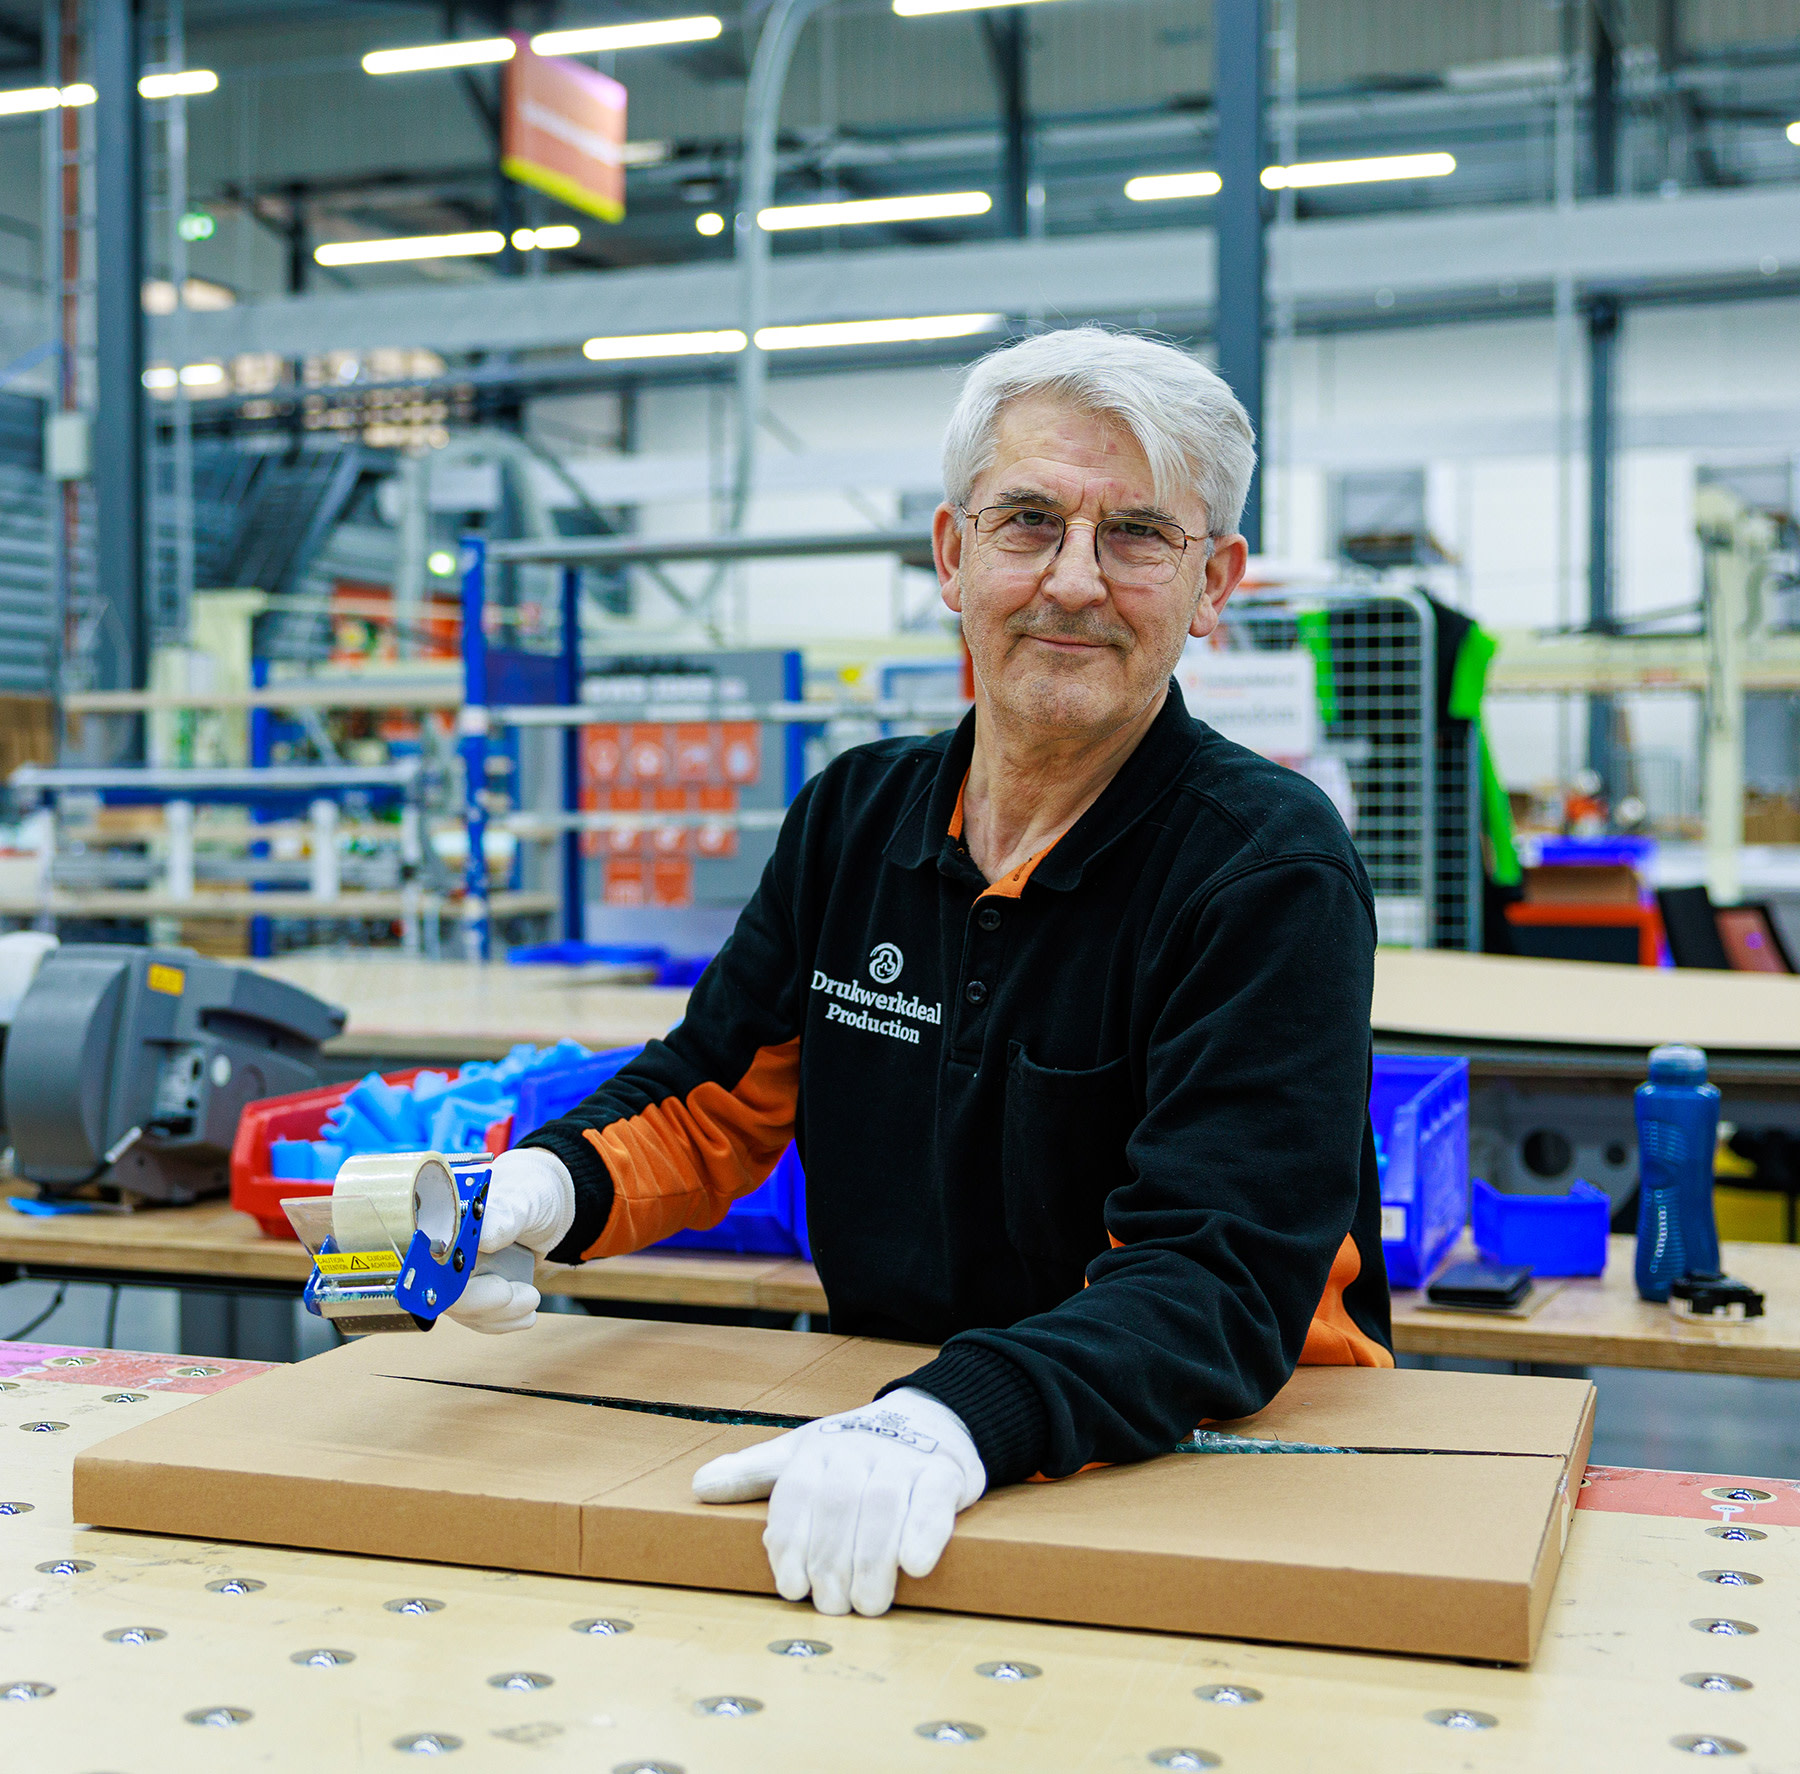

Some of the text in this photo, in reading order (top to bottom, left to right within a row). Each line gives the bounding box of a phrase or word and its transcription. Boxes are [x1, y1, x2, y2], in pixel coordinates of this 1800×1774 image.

[811, 970, 941, 1025] Drukwerkdeal
[825, 1003, 920, 1044] Production
[371, 1261, 399, 1269] ACHTUNG
